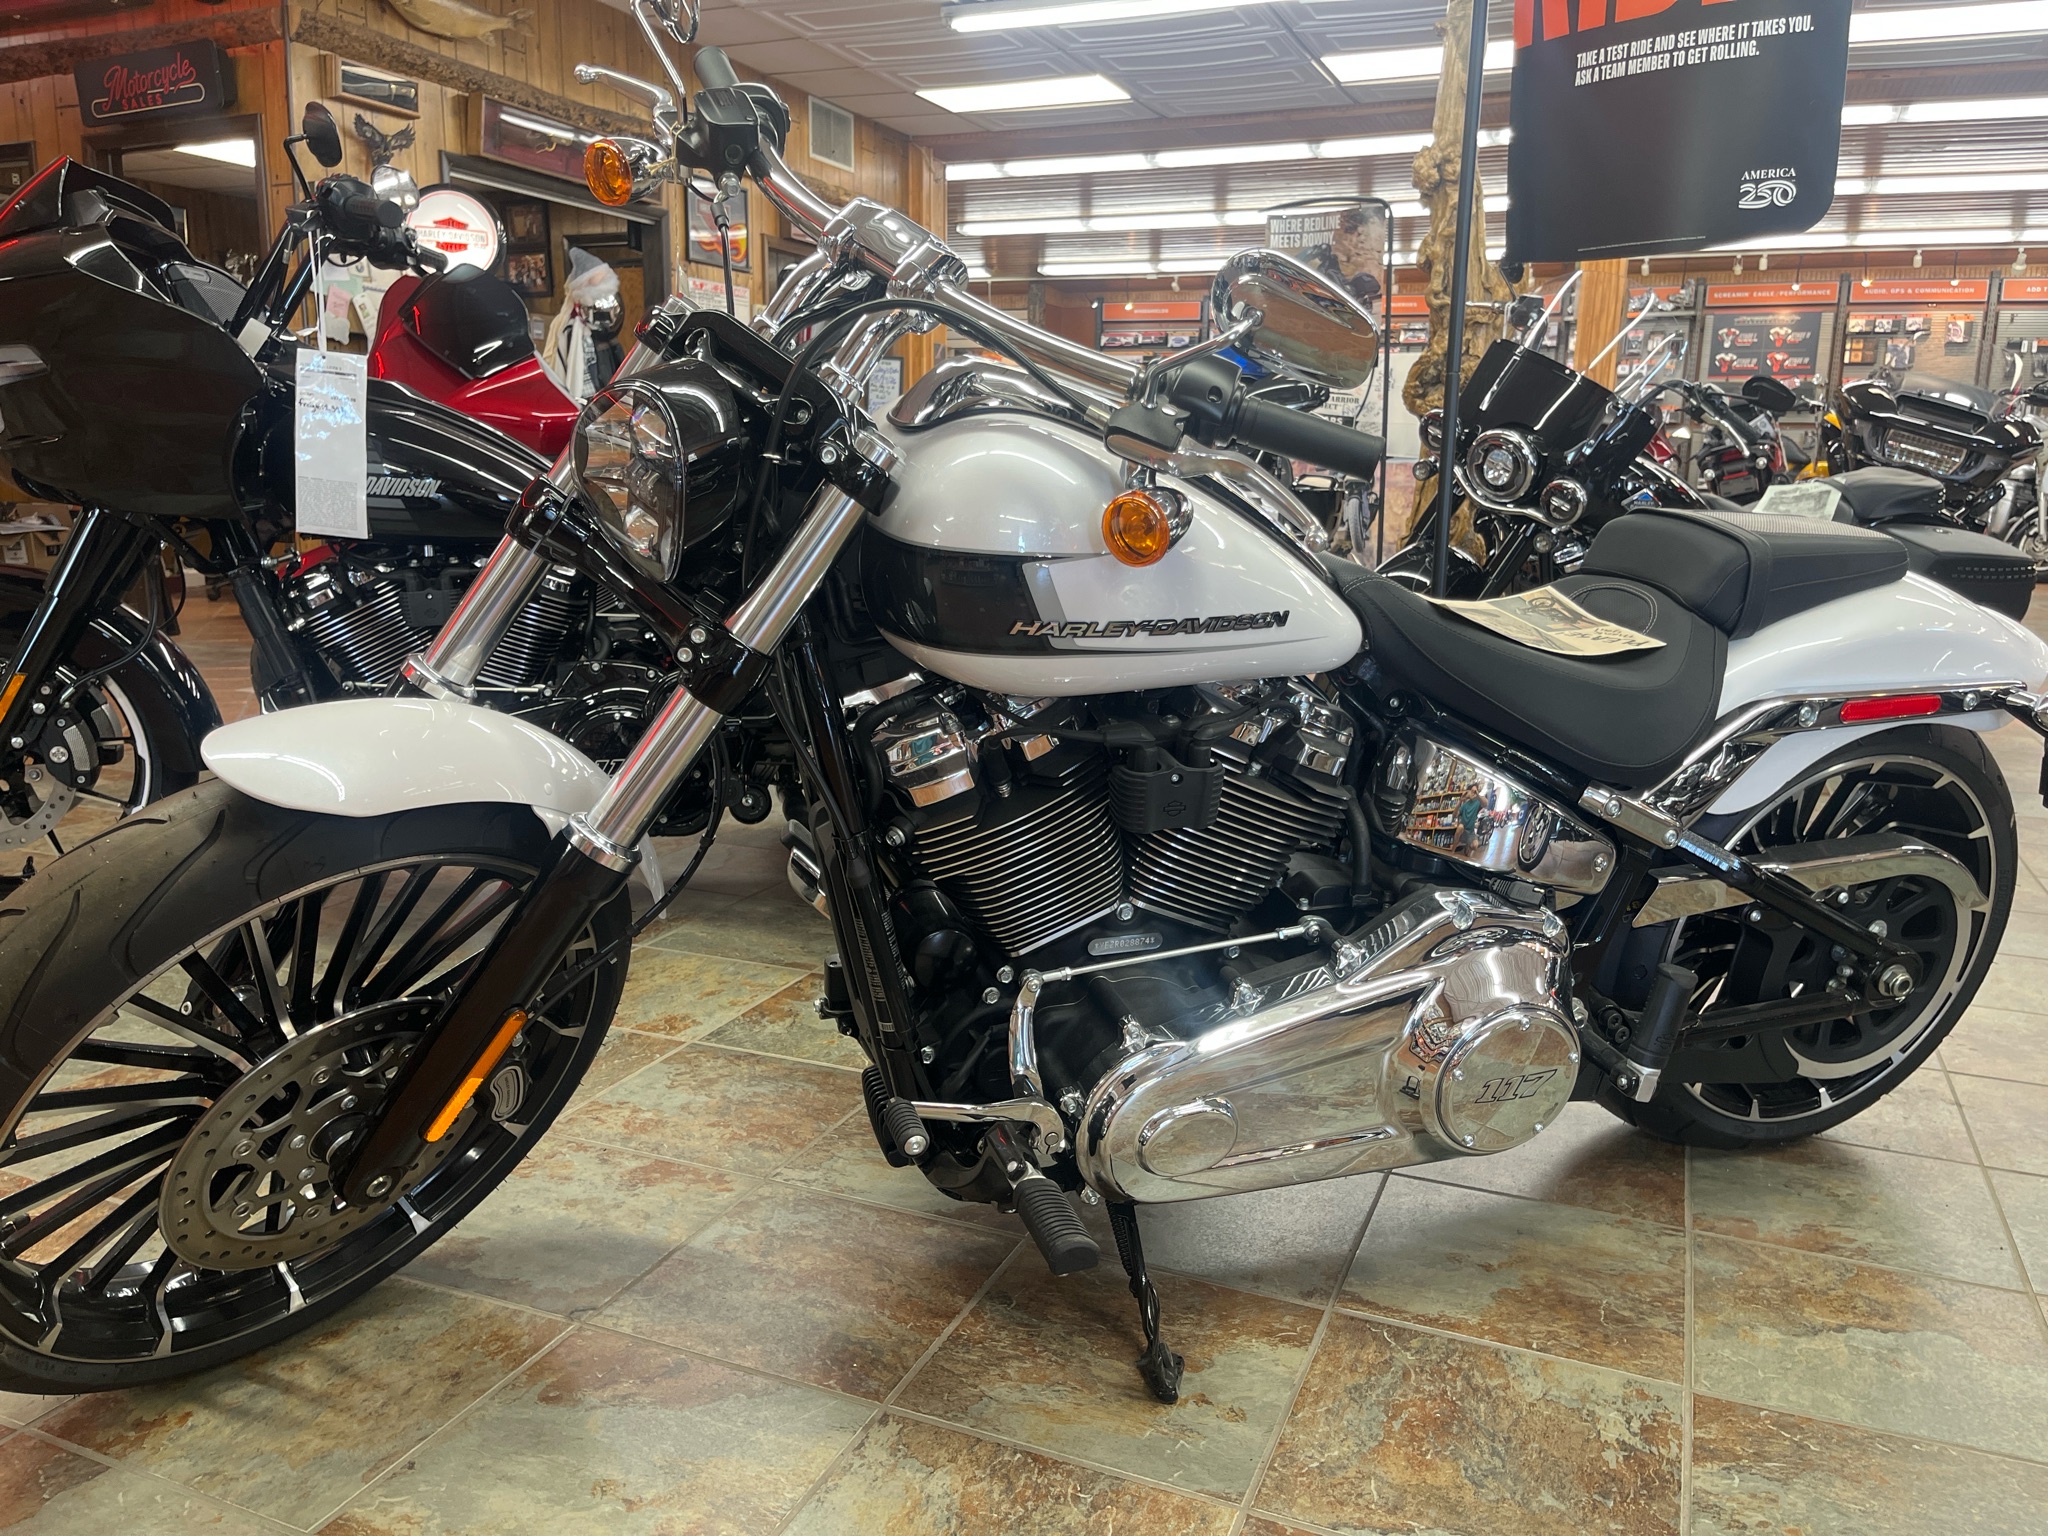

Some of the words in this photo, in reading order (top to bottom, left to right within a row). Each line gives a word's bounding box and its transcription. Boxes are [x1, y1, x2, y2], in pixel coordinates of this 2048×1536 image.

[1577, 49, 1598, 69] TAKE
[1598, 48, 1605, 64] A
[1606, 42, 1629, 62] TEST
[1630, 38, 1653, 57] RIDE
[1654, 34, 1675, 53] AND
[1677, 30, 1697, 49] SEE
[1697, 24, 1736, 46] WHERE
[1737, 22, 1750, 40] IT
[1751, 17, 1786, 38] TAKES
[1788, 14, 1815, 33] YOU.
[1574, 68, 1593, 87] ASK
[1593, 66, 1600, 83] A
[1601, 60, 1626, 81] TEAM
[1627, 52, 1670, 76] MEMBER
[1672, 50, 1686, 68] TO
[1687, 46, 1709, 65] GET
[1709, 39, 1760, 62] ROLLING.
[102, 51, 197, 111] Motorcycle
[121, 93, 163, 111] SALES
[1741, 167, 1797, 181] AMERICA
[1738, 180, 1797, 209] 250
[1270, 217, 1303, 234] WHERE
[1303, 214, 1342, 232] REDLINE
[1269, 233, 1301, 249] MEETS
[1302, 231, 1336, 248] ROWDY.
[1915, 286, 1975, 294] COMMUNICATION
[1331, 395, 1360, 404] ARRIOR
[366, 475, 442, 498] DAVIDSON
[1008, 610, 1290, 639] HARLEY-DAVIDSON
[1474, 1068, 1558, 1104] 117
